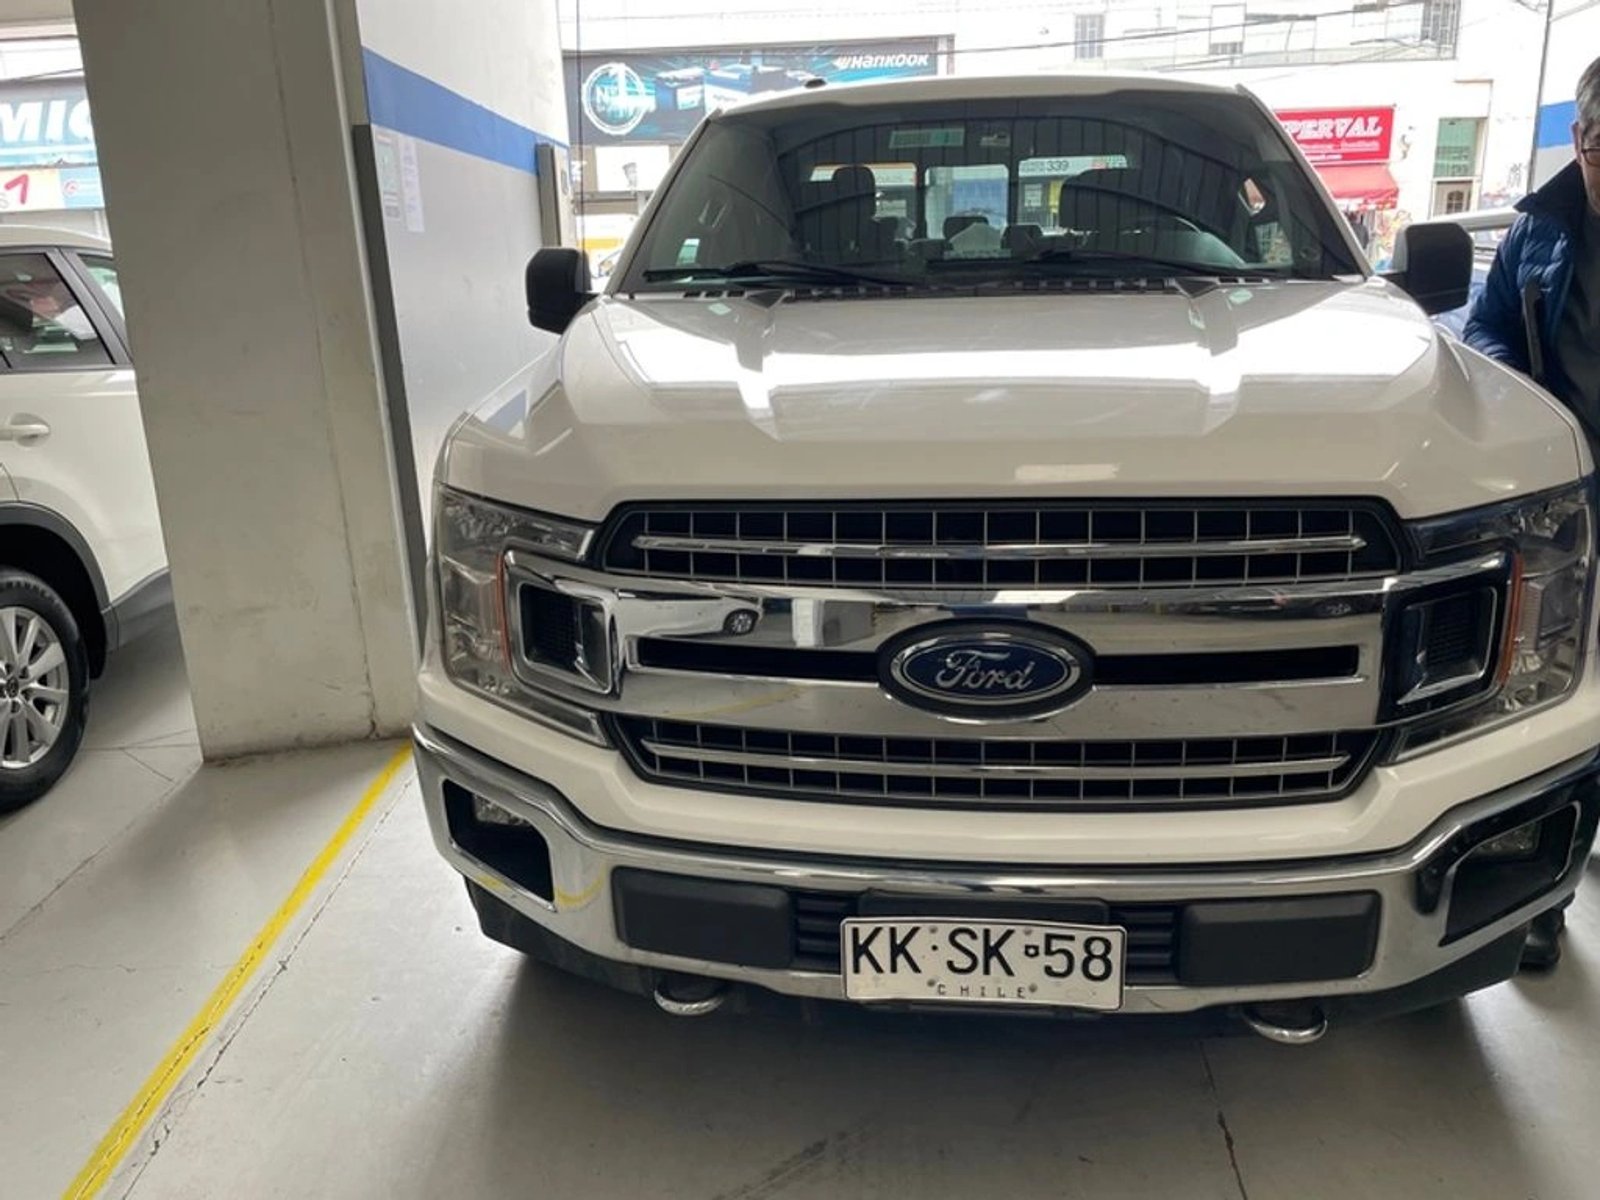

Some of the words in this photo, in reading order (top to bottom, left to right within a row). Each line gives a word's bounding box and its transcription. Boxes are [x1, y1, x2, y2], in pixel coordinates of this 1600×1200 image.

[1046, 160, 1069, 172] 339
[936, 649, 1035, 690] Ford
[937, 983, 1026, 1000] CHILE
